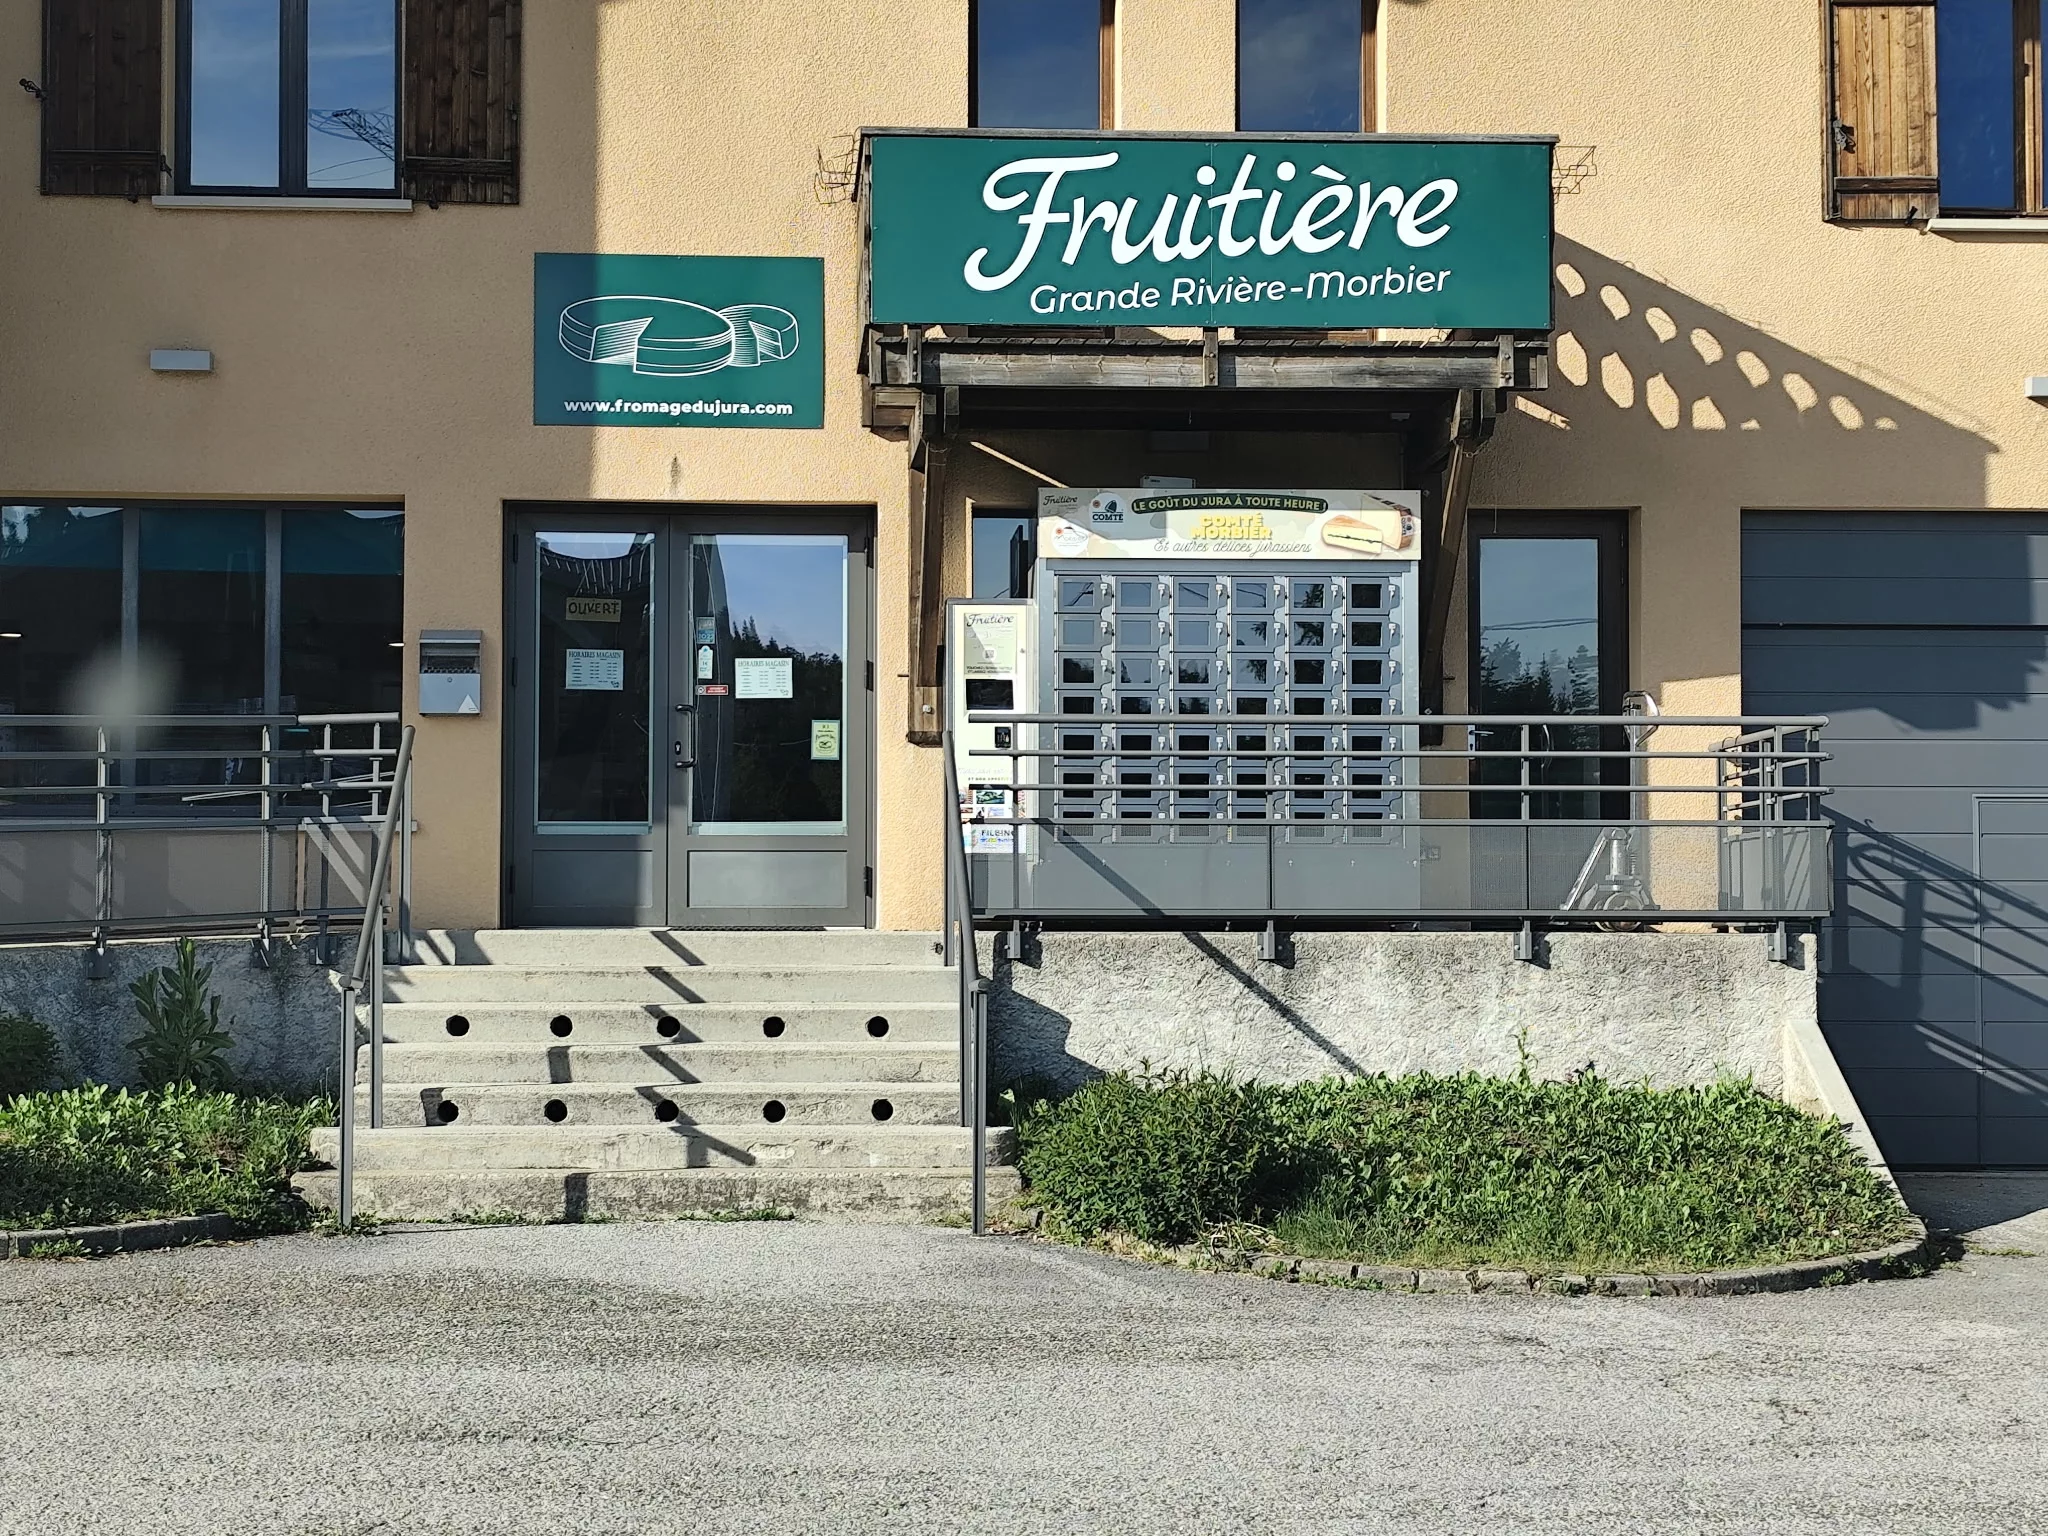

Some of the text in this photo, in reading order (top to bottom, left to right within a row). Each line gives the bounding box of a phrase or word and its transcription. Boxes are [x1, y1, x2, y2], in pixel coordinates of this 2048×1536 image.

[963, 151, 1459, 291] Fruitière
[1029, 265, 1452, 315] Grande Rivière-Morbier
[564, 399, 793, 417] www.fromagedujura.com
[1133, 502, 1146, 512] LE
[1148, 496, 1179, 510] GOÛT
[1182, 497, 1198, 507] DU
[1201, 497, 1232, 506] JURA
[1234, 494, 1243, 505] À
[1245, 496, 1281, 508] TOUTE
[1284, 498, 1320, 511] HEURE
[1200, 513, 1264, 528] COMTÉ
[1191, 526, 1274, 540] MORBIER
[1154, 539, 1313, 557] Et autres délices jurassiens
[568, 602, 619, 615] OUVERT
[568, 651, 621, 659] HORAIRES MAGASIN
[738, 660, 764, 668] HORAIRES
